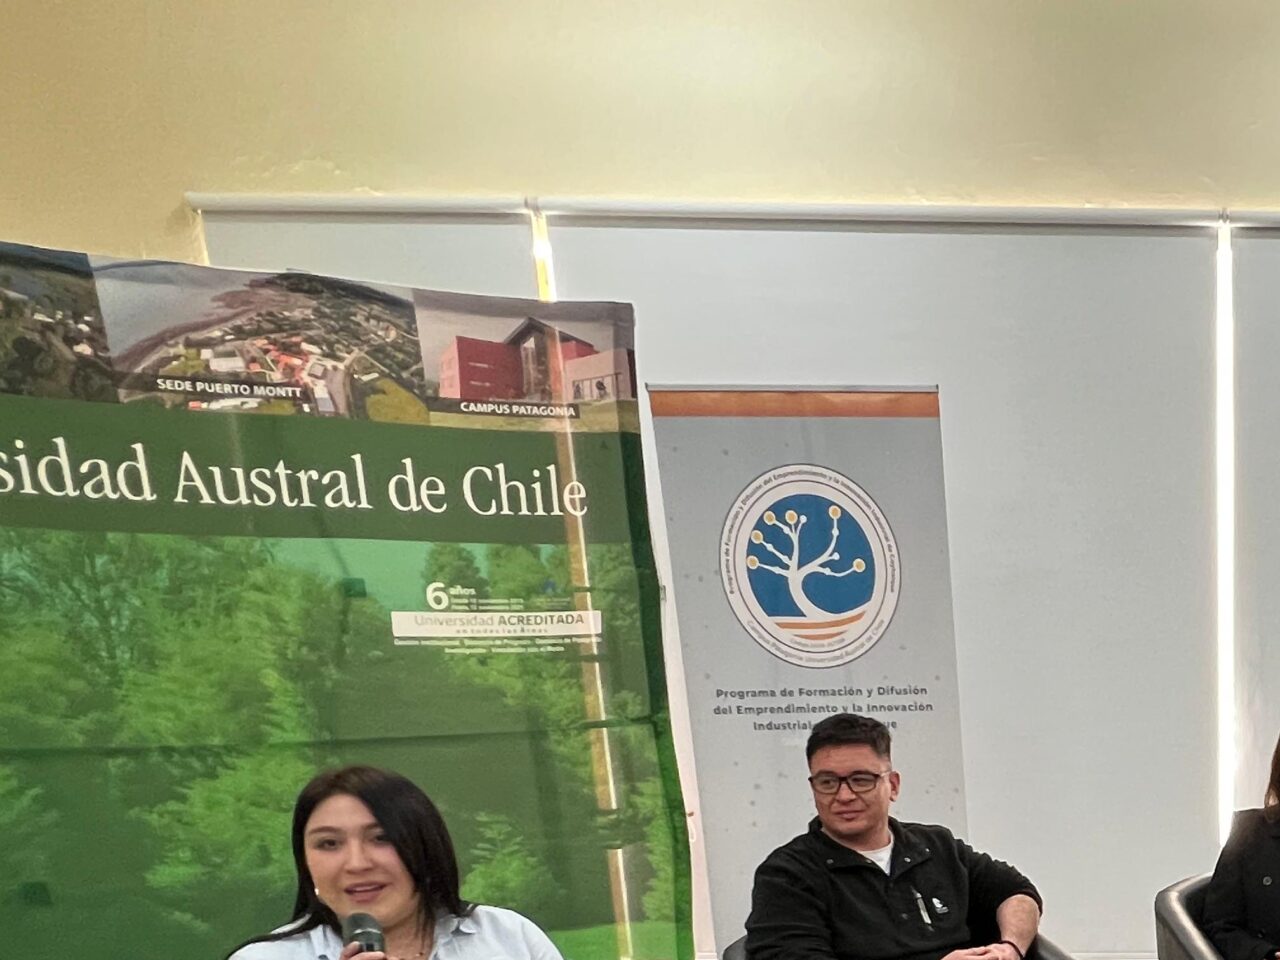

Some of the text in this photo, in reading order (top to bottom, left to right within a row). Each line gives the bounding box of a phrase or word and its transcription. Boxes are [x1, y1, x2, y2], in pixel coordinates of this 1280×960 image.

[156, 378, 302, 398] SEDE PUERTO MONTT
[460, 402, 576, 416] CAMPUS PATAGONIA
[174, 453, 373, 508] Austral
[388, 457, 447, 513] de
[462, 462, 588, 516] Chile
[426, 582, 476, 610] 6 años
[414, 614, 585, 627] Universidad ACREDITADA
[716, 685, 928, 701] Programa de Formación y Difusión
[713, 704, 732, 715] del
[736, 703, 838, 716] Emprendimiento
[852, 703, 863, 713] la
[867, 702, 933, 712] Innovación
[753, 720, 813, 731] Industrial
